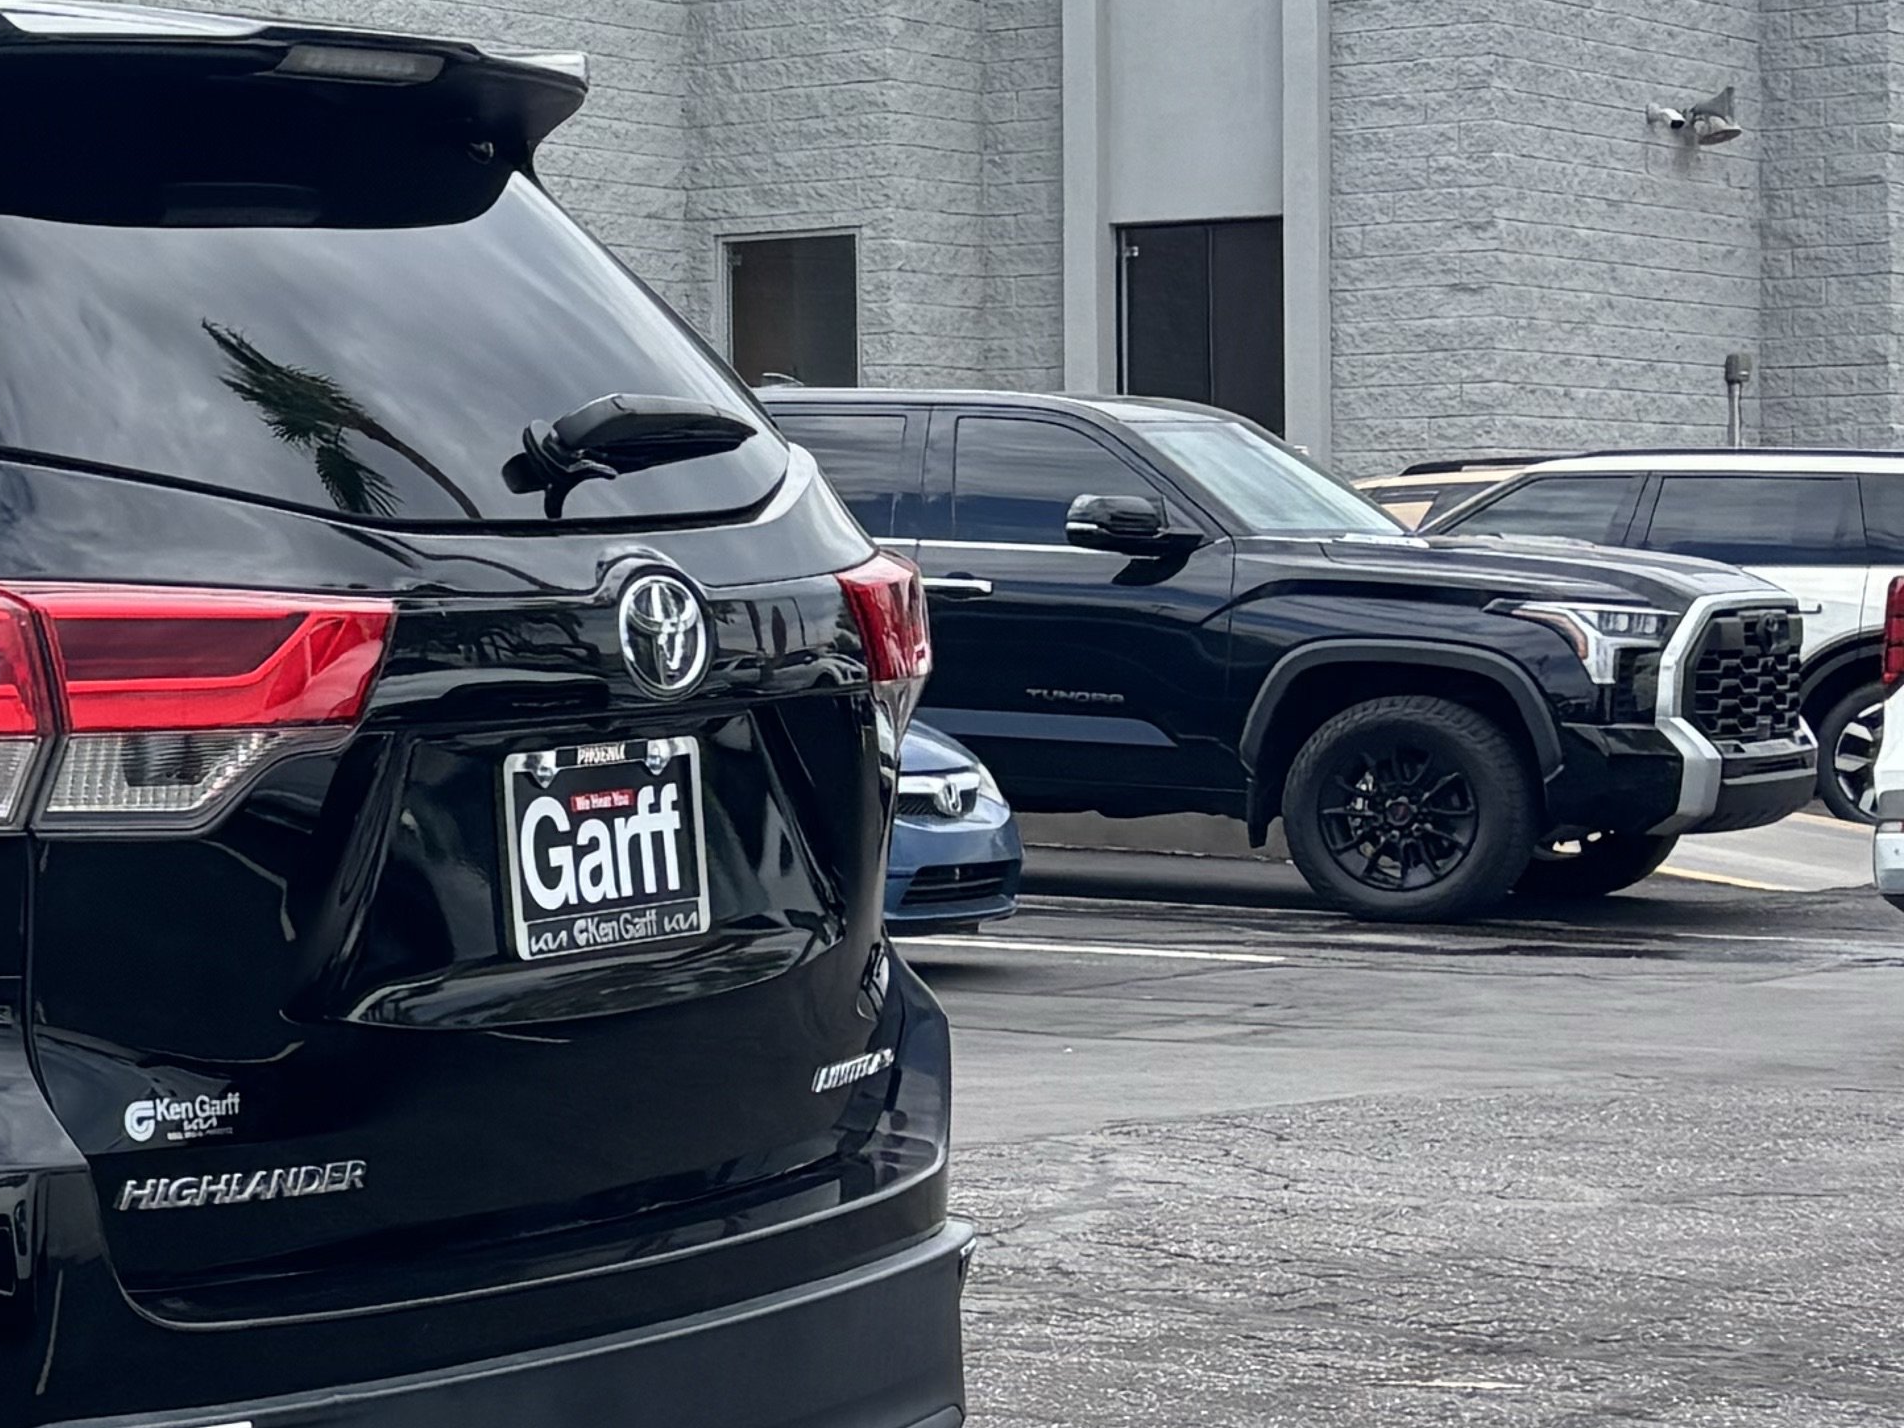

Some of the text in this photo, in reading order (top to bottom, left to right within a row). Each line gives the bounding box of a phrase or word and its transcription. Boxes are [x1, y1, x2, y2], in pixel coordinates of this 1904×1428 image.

[1025, 687, 1124, 703] TUNDRA
[520, 782, 681, 910] Garff
[587, 916, 620, 945] Ken
[619, 908, 657, 940] Garff
[155, 1097, 194, 1121] Ken
[195, 1091, 240, 1118] Garff
[116, 1159, 367, 1211] HIGHLANDER
